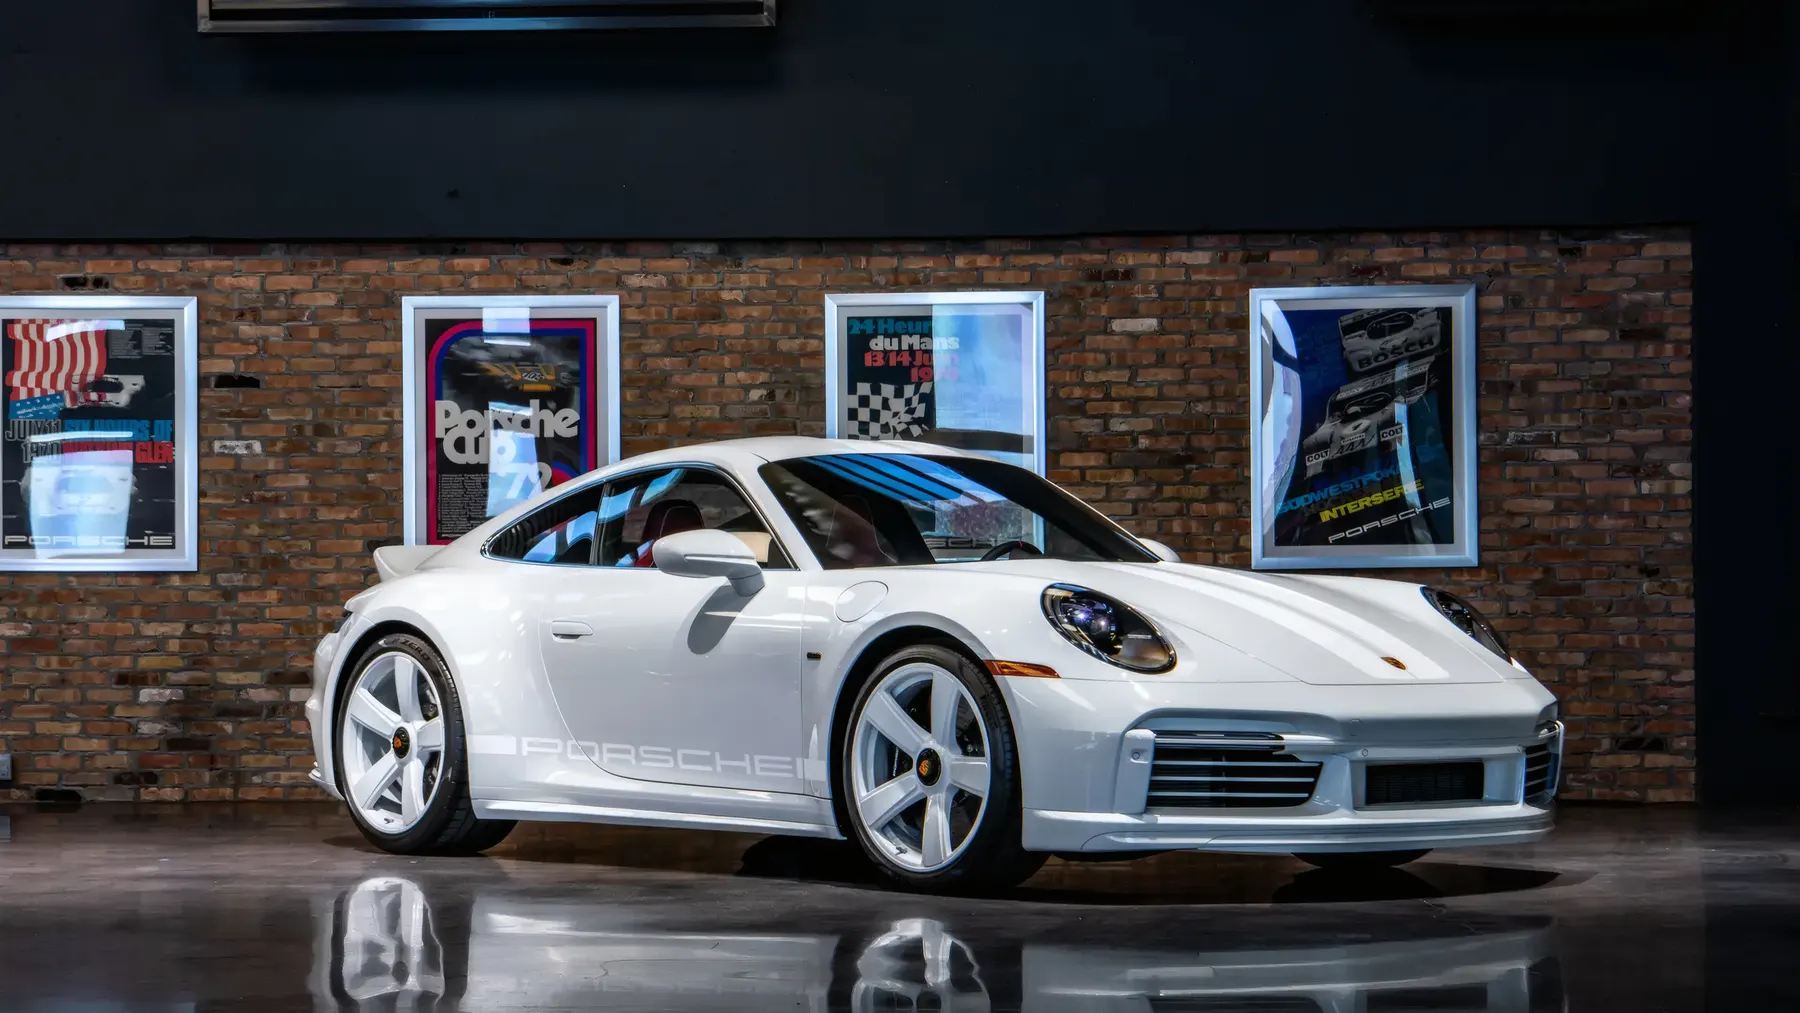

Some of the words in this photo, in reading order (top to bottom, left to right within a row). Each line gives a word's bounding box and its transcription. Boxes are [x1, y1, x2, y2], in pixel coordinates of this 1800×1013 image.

[848, 318, 876, 335] 24
[877, 317, 957, 335] Heur
[869, 335, 899, 351] du
[901, 334, 960, 351] Mans
[864, 351, 912, 367] 13/14
[1357, 336, 1435, 370] BOSCH
[435, 398, 581, 439] Porsche
[1382, 425, 1404, 439] COLT
[442, 428, 517, 466] Cup
[1307, 449, 1329, 463] COLT
[1327, 497, 1452, 545] PORSCHE
[4, 535, 173, 546] PORSCHE
[400, 639, 430, 661] ZERO
[520, 735, 794, 780] PORSCHE
